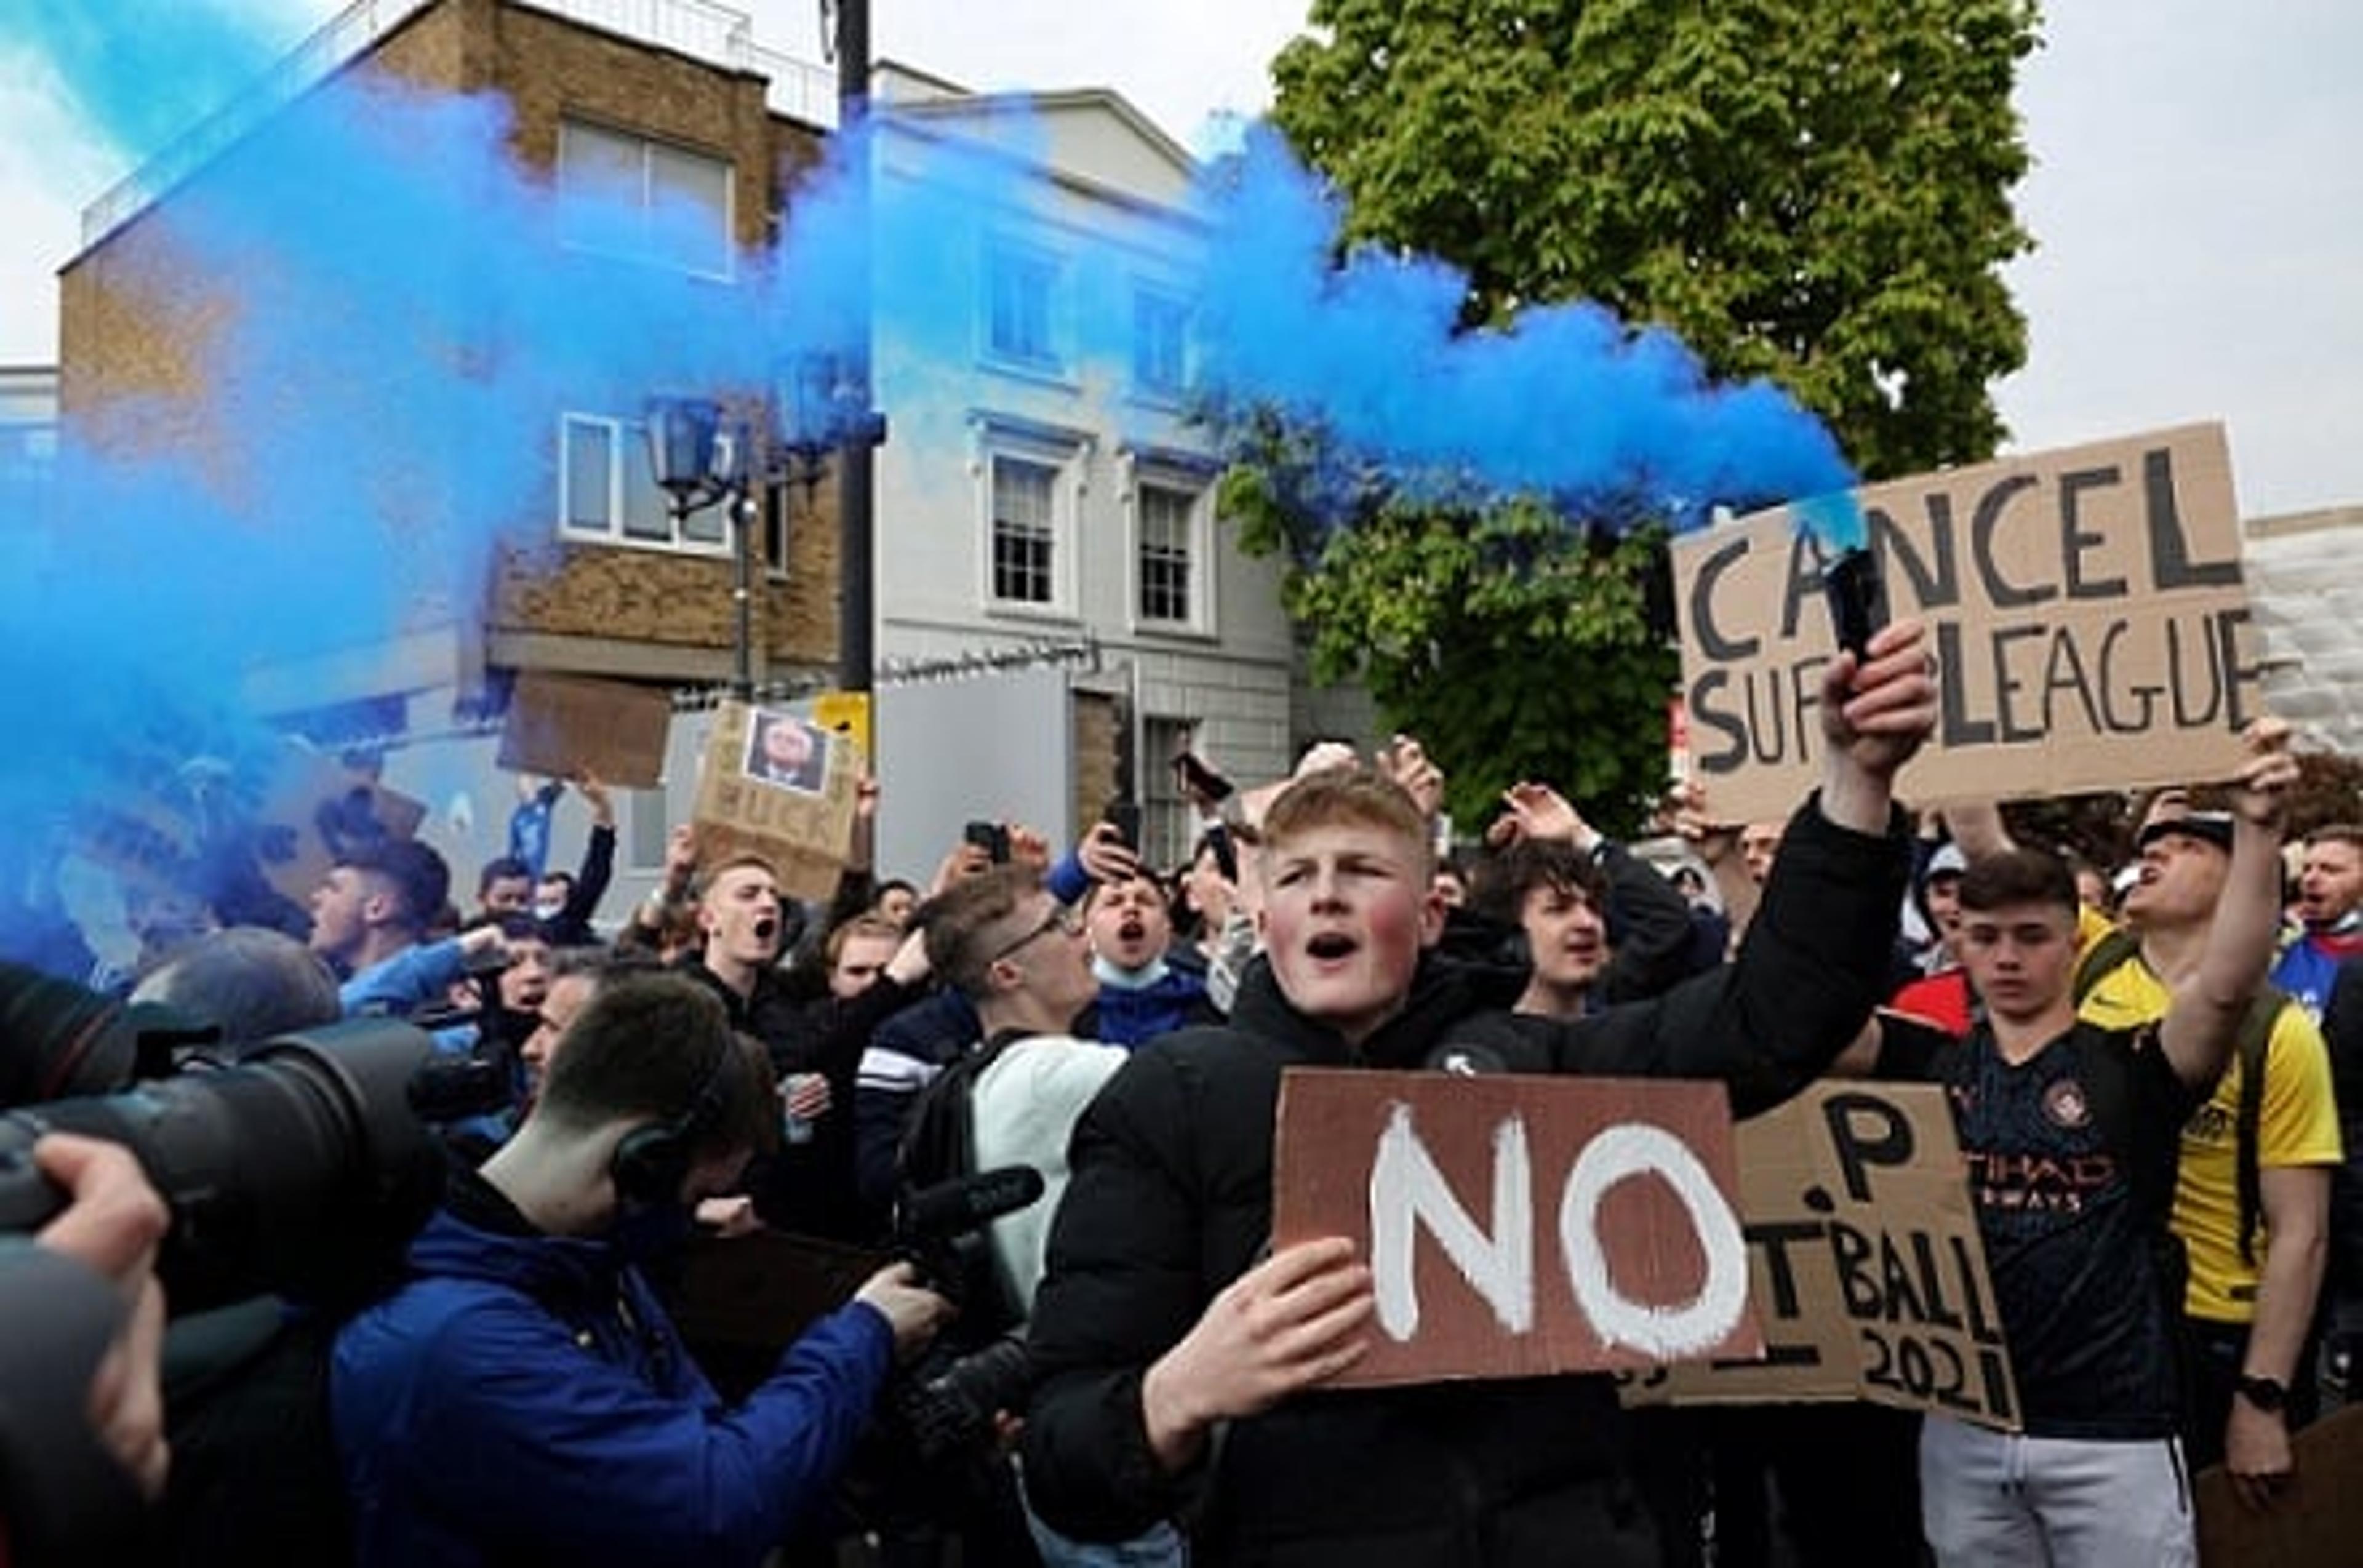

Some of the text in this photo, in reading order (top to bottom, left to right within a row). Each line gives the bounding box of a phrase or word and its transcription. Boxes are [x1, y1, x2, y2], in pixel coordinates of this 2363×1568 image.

[1691, 447, 2243, 662] CANCEL
[1938, 610, 2260, 745] LEAGUE
[1369, 1100, 1747, 1355] NO
[1862, 1328, 2013, 1417] 2021
